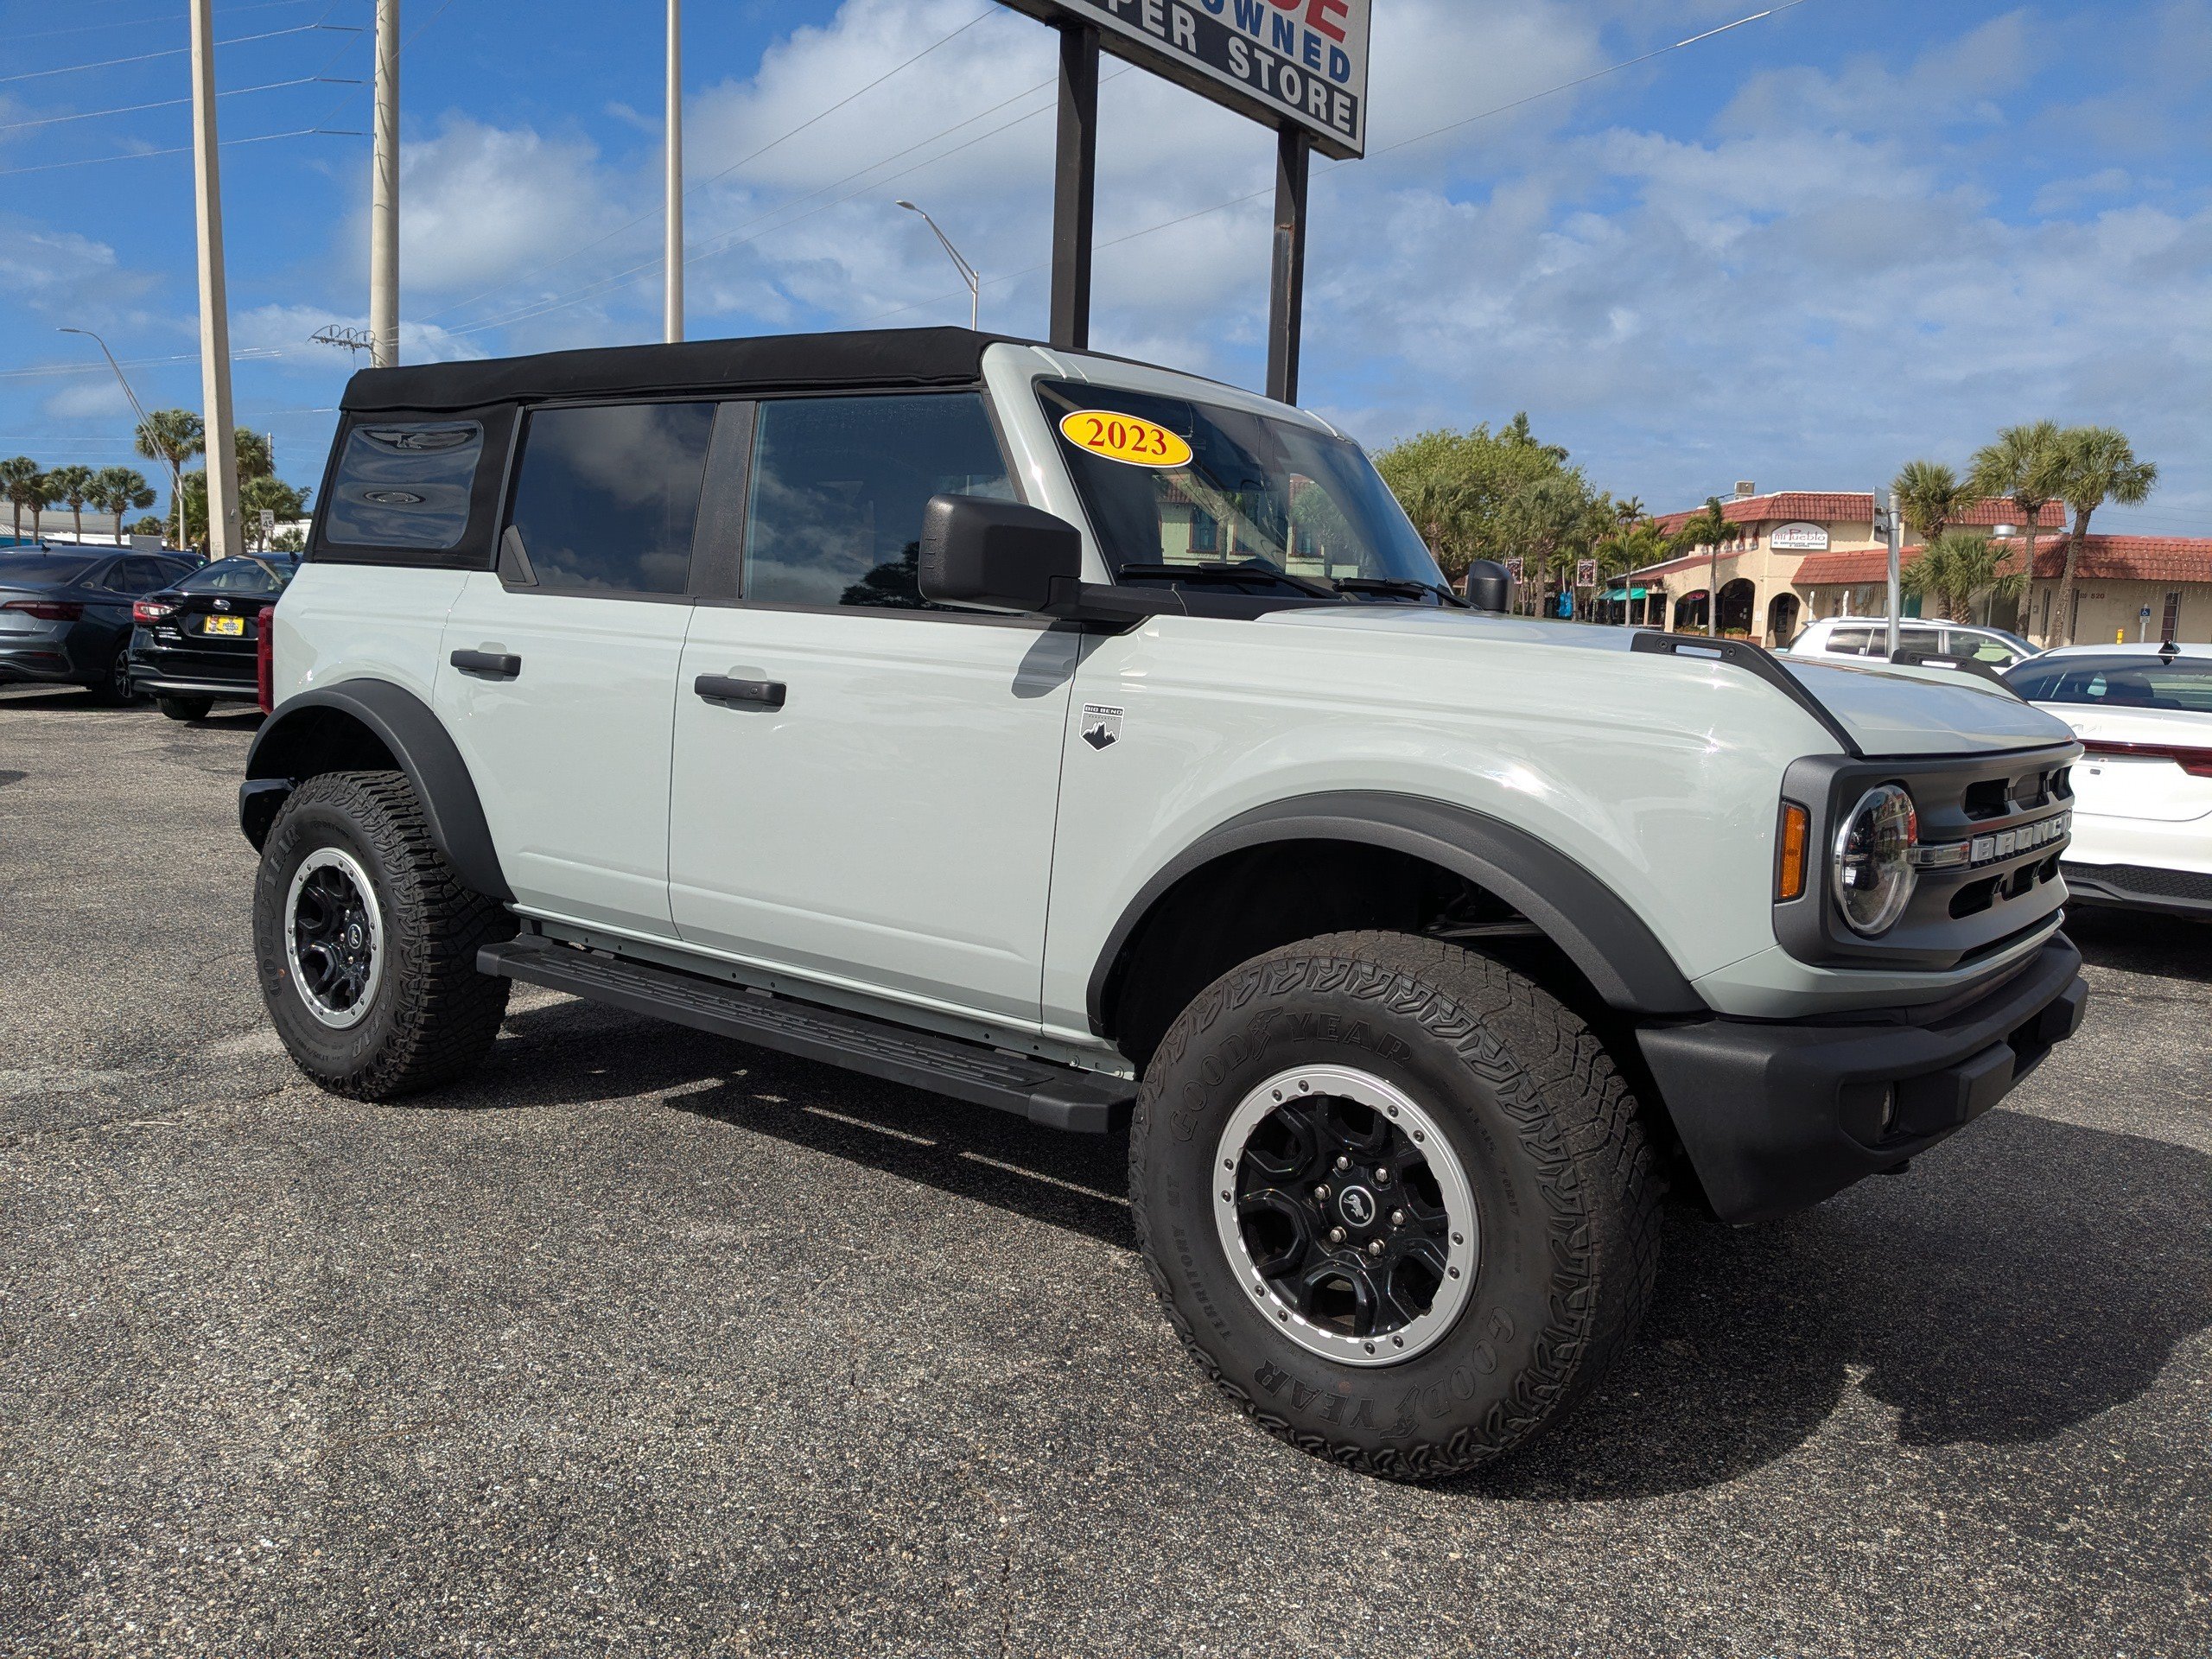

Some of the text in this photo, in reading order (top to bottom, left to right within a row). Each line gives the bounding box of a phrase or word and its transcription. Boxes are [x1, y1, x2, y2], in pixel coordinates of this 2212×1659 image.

[1228, 36, 1351, 132] STORE
[1086, 418, 1167, 455] 2023
[1789, 529, 1826, 541] Pueblo
